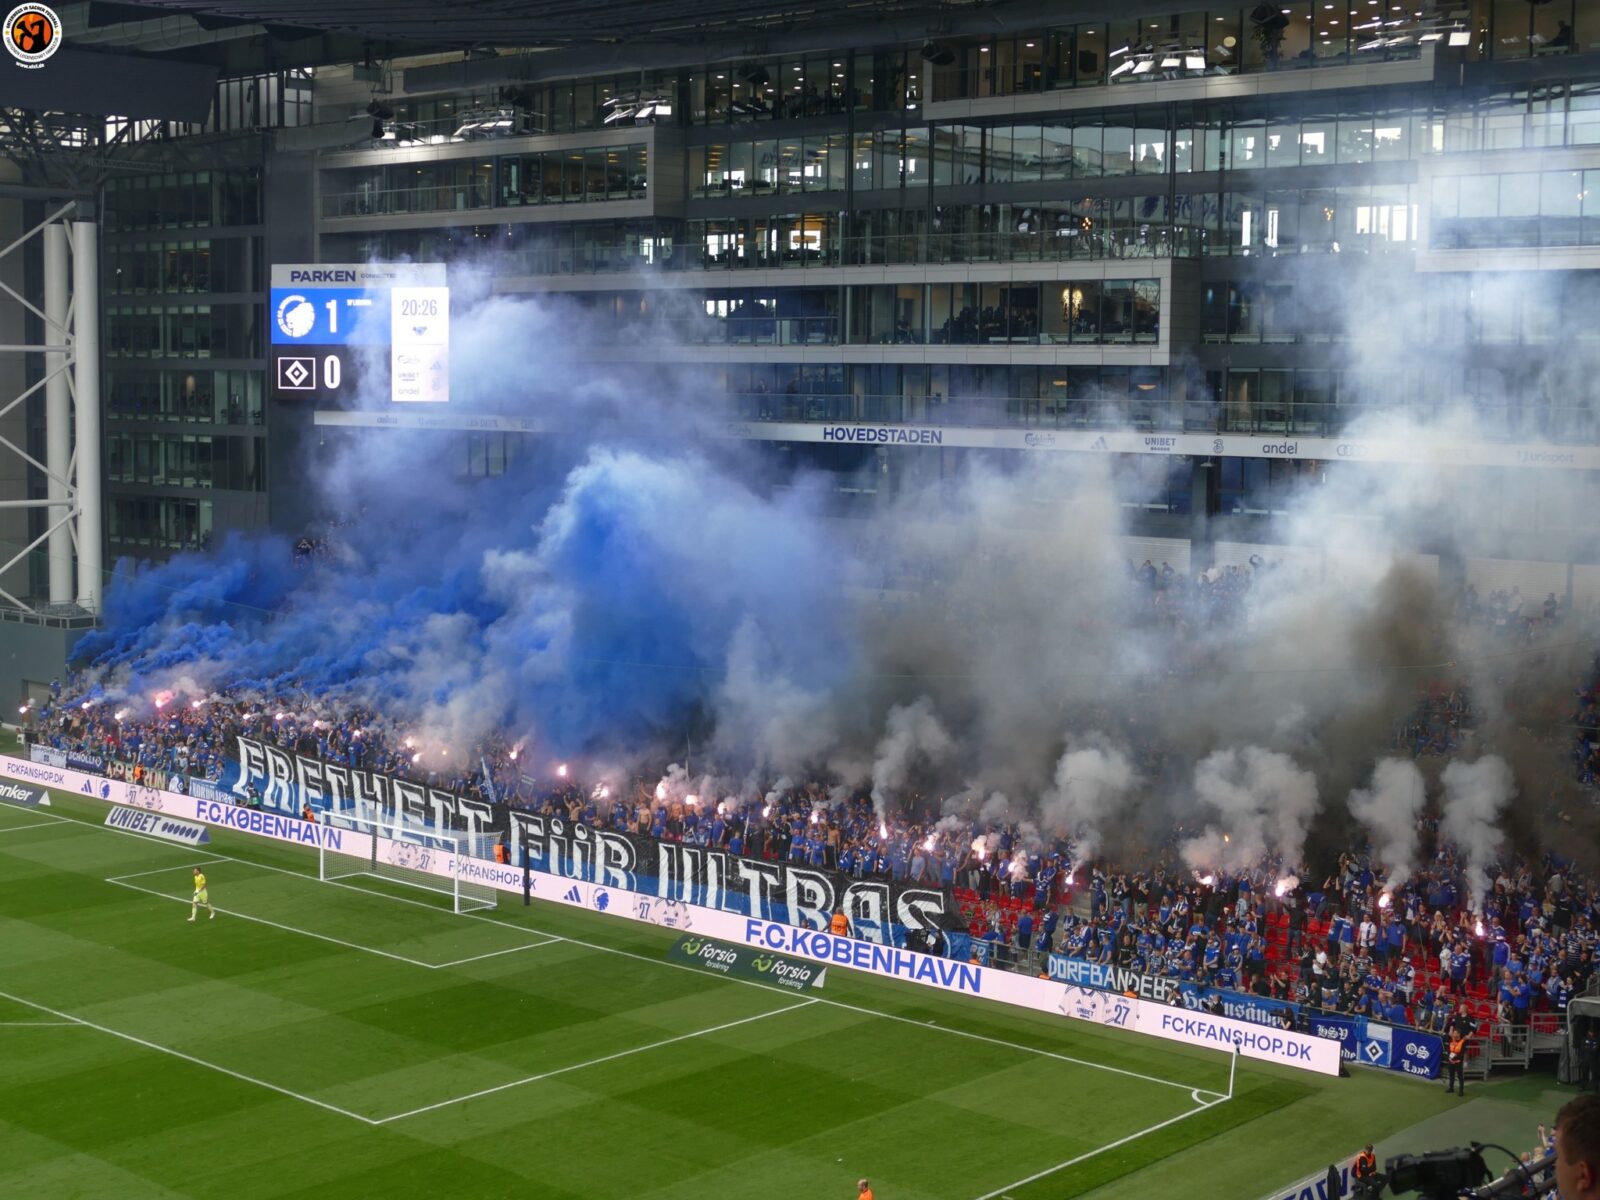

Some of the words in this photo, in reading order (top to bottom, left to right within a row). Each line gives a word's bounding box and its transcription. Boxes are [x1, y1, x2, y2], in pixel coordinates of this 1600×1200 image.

[291, 270, 356, 282] PARKEN
[325, 299, 337, 333] 1
[401, 299, 438, 316] 20:26
[323, 354, 341, 389] 0
[823, 427, 942, 444] HOVEDSTADEN
[1144, 437, 1177, 446] UNIBET
[1262, 441, 1298, 454] andel
[7, 762, 65, 784] FCKFANSHOP.DK
[129, 790, 137, 804] 27
[233, 736, 492, 858] FREIHEIT
[109, 807, 161, 833] UNIBET
[419, 853, 431, 871] 27
[639, 902, 651, 920] 27
[699, 943, 738, 964] forsia
[769, 960, 812, 981] forsia
[1114, 1004, 1131, 1026] 27
[1162, 1014, 1311, 1061] FCKFANSHOP.DK
[1316, 1024, 1349, 1041] HSV
[1405, 1042, 1430, 1060] OS
